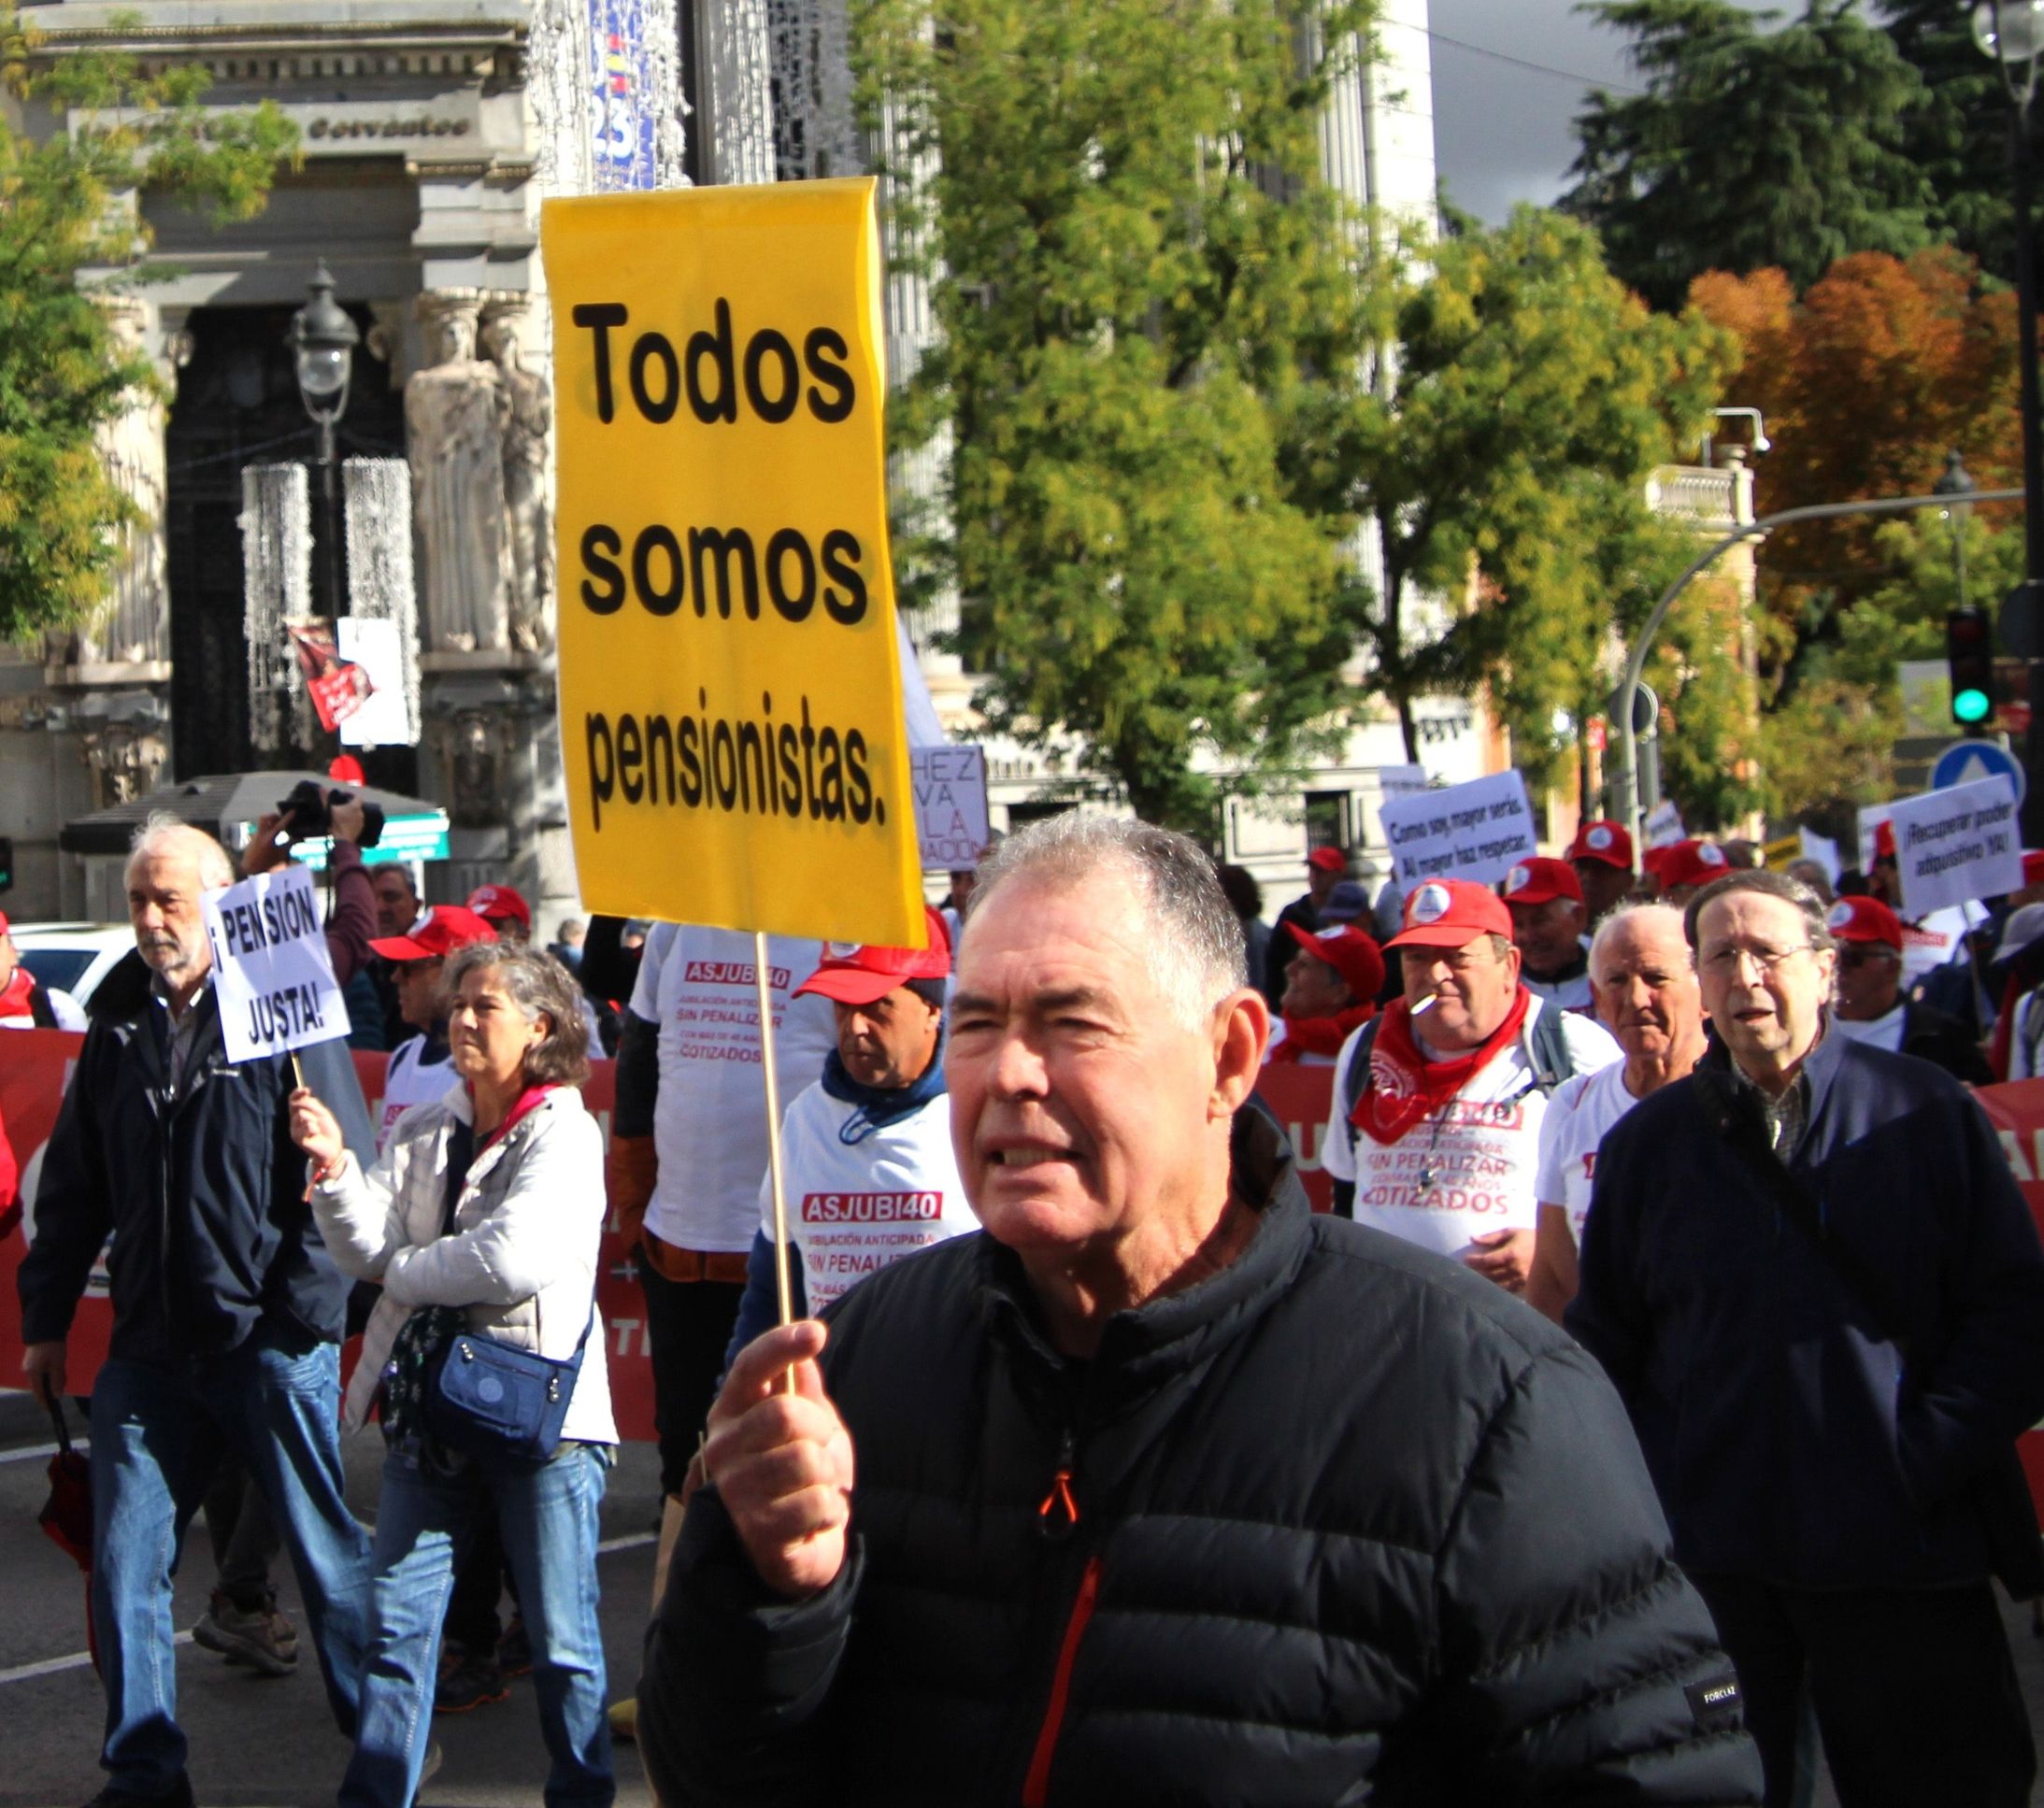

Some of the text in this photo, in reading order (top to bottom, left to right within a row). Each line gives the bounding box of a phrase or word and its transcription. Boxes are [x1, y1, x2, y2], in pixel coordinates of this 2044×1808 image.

[572, 296, 855, 424] Todos
[579, 523, 867, 625] somos
[585, 686, 885, 833] pensionistas.
[1390, 822, 1428, 845] Como
[1451, 806, 1487, 832] mayor
[1419, 853, 1453, 876] mayor
[249, 981, 324, 1045] JUSTA!
[700, 1009, 782, 1029] PENALIZR
[679, 1043, 763, 1063] COTIZADOS
[807, 1192, 937, 1221] ASJUBI40
[1362, 1185, 1508, 1215] COTIZADOS
[1704, 1686, 1736, 1704] FORCLAZ
